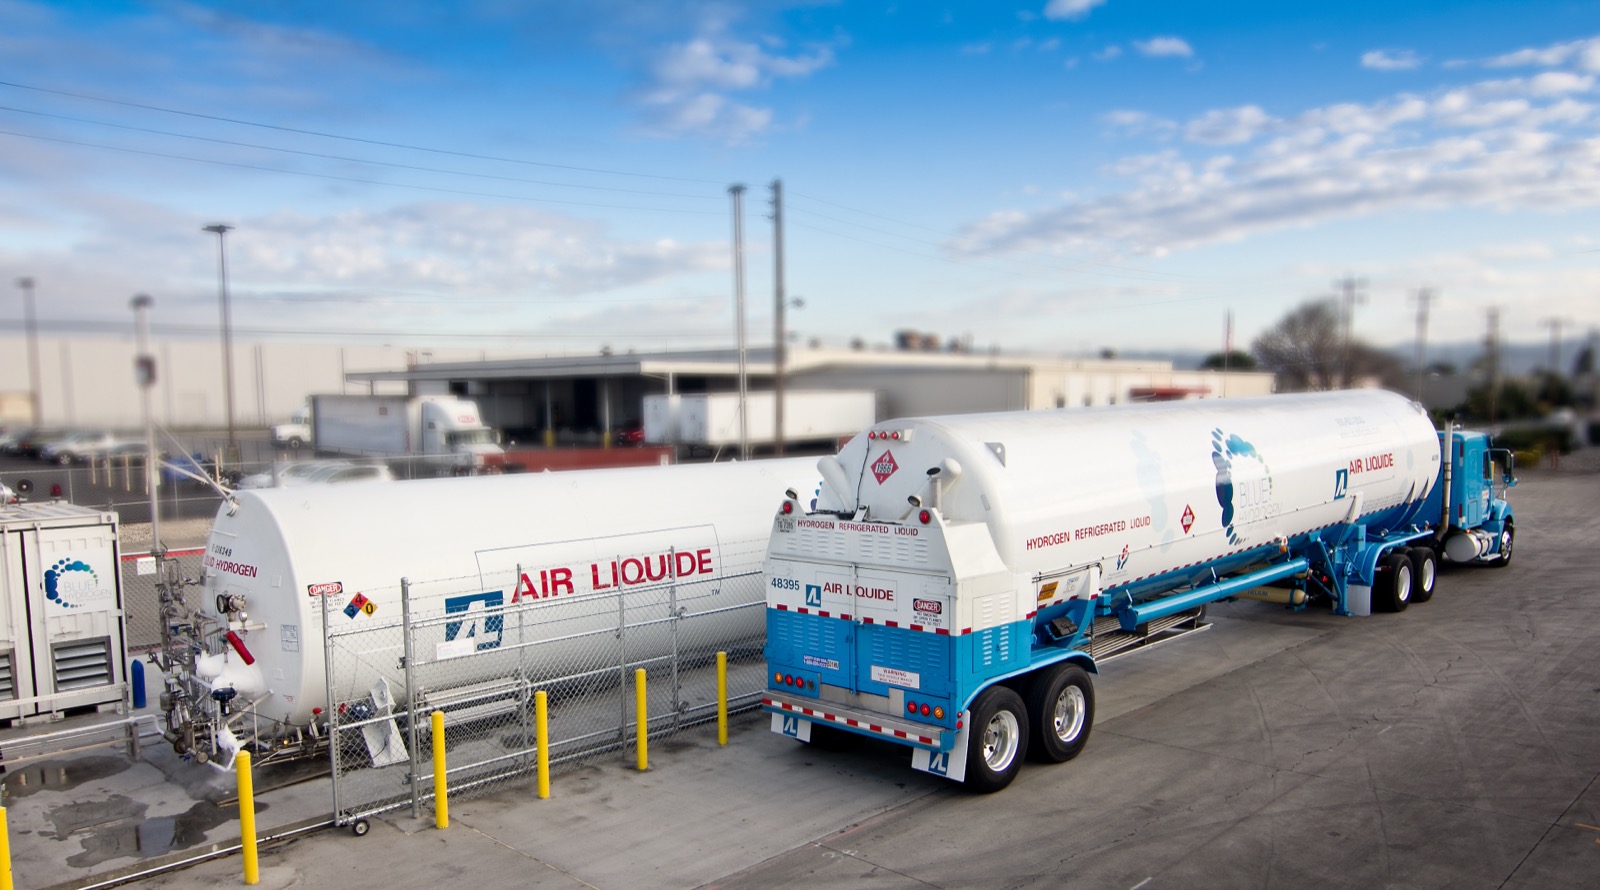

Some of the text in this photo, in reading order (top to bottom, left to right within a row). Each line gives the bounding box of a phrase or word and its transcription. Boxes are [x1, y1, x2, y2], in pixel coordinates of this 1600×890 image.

[1349, 453, 1394, 475] AIR LIQUIDE
[1240, 478, 1268, 508] BLUE
[797, 519, 919, 537] HYDROGEN REFRIGERATED LIQUID
[1026, 515, 1151, 551] HYDROGEN REFRIGERATED LIQUID
[215, 559, 258, 578] HYDROGEN
[511, 548, 714, 604] AIR LIQUIDE
[64, 578, 95, 593] BLUE
[312, 584, 338, 594] DANGER
[771, 577, 800, 591] 48395
[823, 582, 894, 601] AIR LQUIDE
[355, 593, 363, 604] 4
[917, 601, 938, 611] DANGER
[347, 605, 355, 616] 3
[365, 602, 374, 615] 0
[883, 668, 907, 677] WARNING
